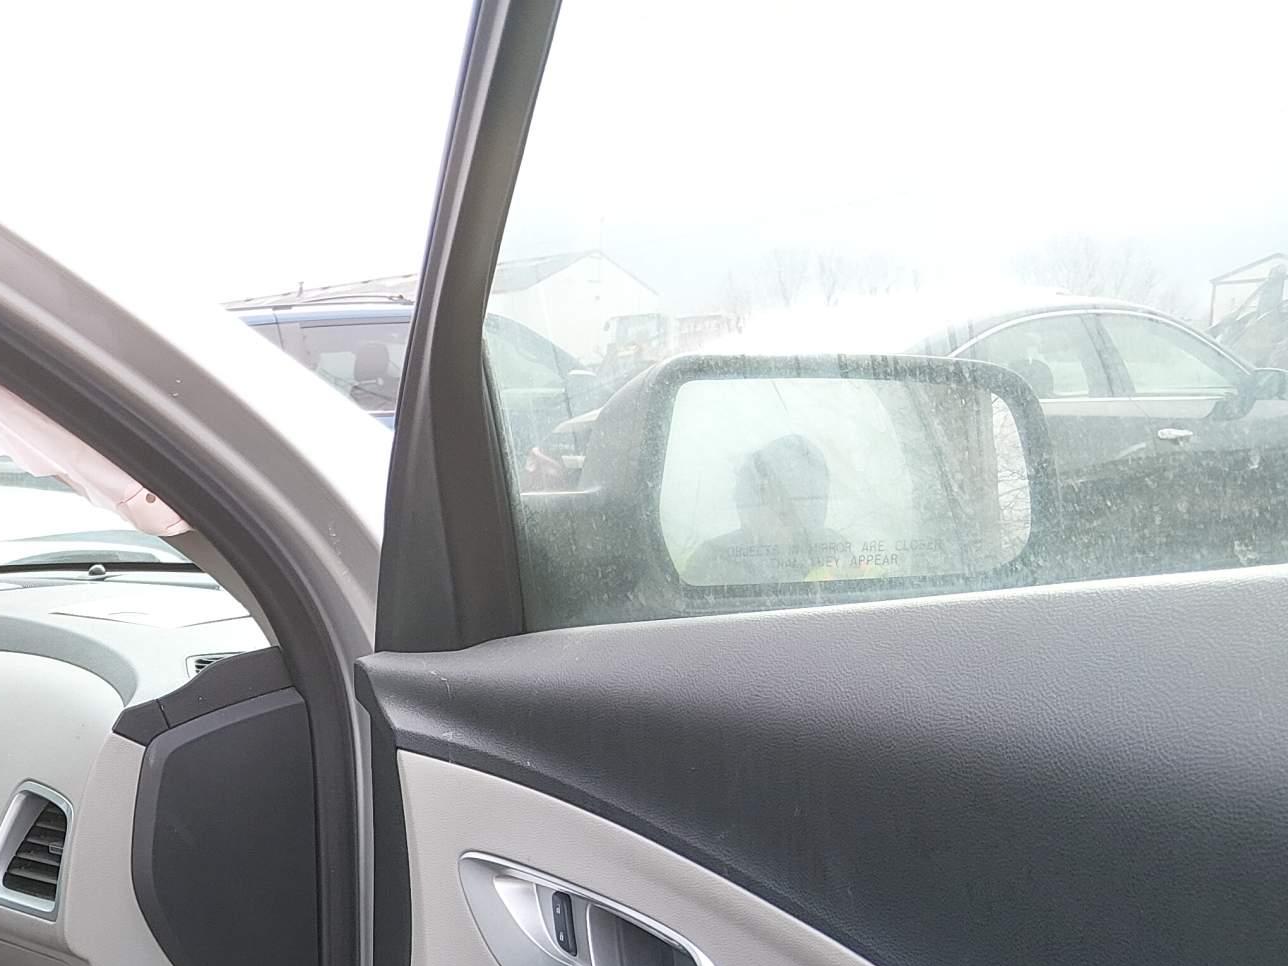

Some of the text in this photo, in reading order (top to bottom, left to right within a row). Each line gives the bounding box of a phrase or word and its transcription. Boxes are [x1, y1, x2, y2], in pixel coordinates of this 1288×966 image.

[861, 540, 886, 553] ARE
[894, 538, 942, 552] CLOSER
[850, 552, 898, 566] APPEAR
